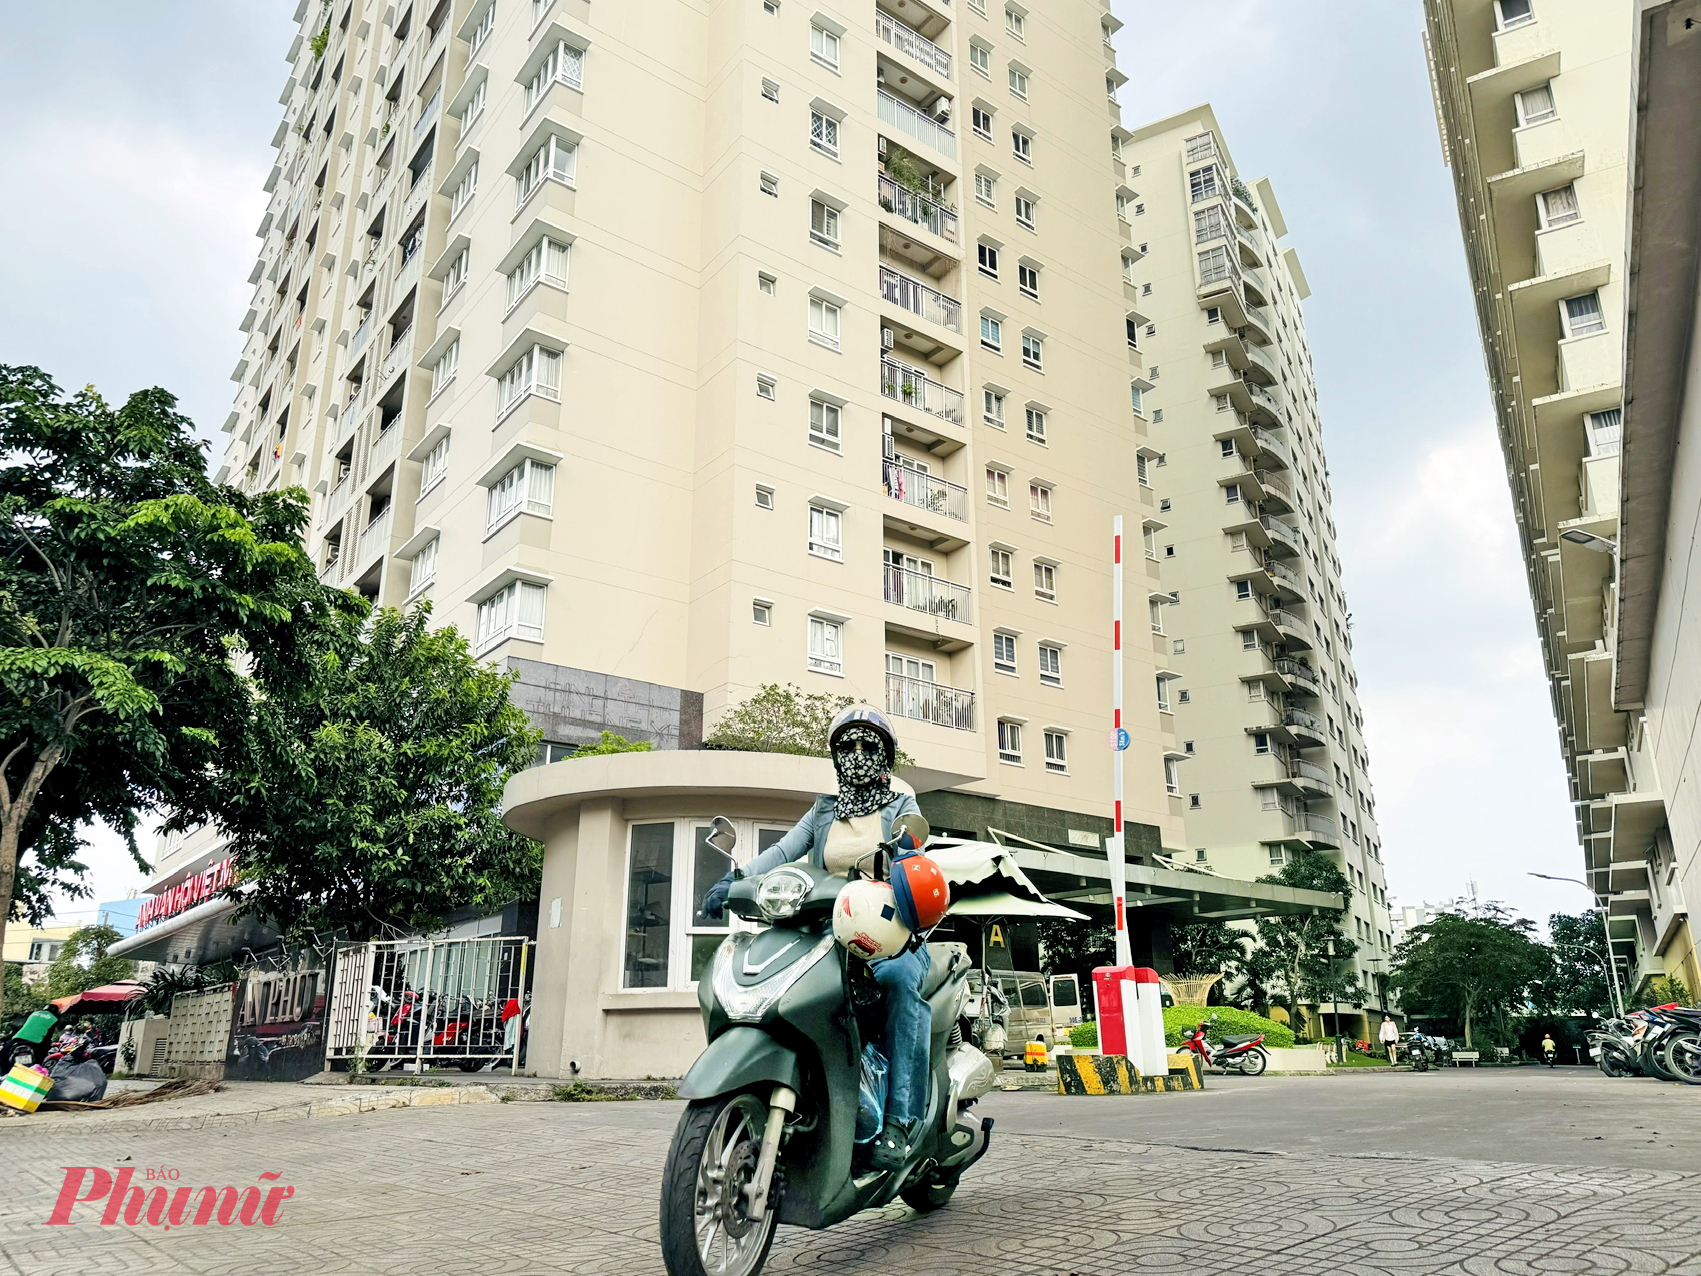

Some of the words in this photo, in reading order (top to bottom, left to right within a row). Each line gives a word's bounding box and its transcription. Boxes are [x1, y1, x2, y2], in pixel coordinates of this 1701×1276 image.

[136, 898, 155, 928] ANH
[173, 871, 193, 912] HỘI
[193, 857, 222, 901] VIỆT
[989, 925, 1005, 947] A
[237, 978, 264, 1027] AN
